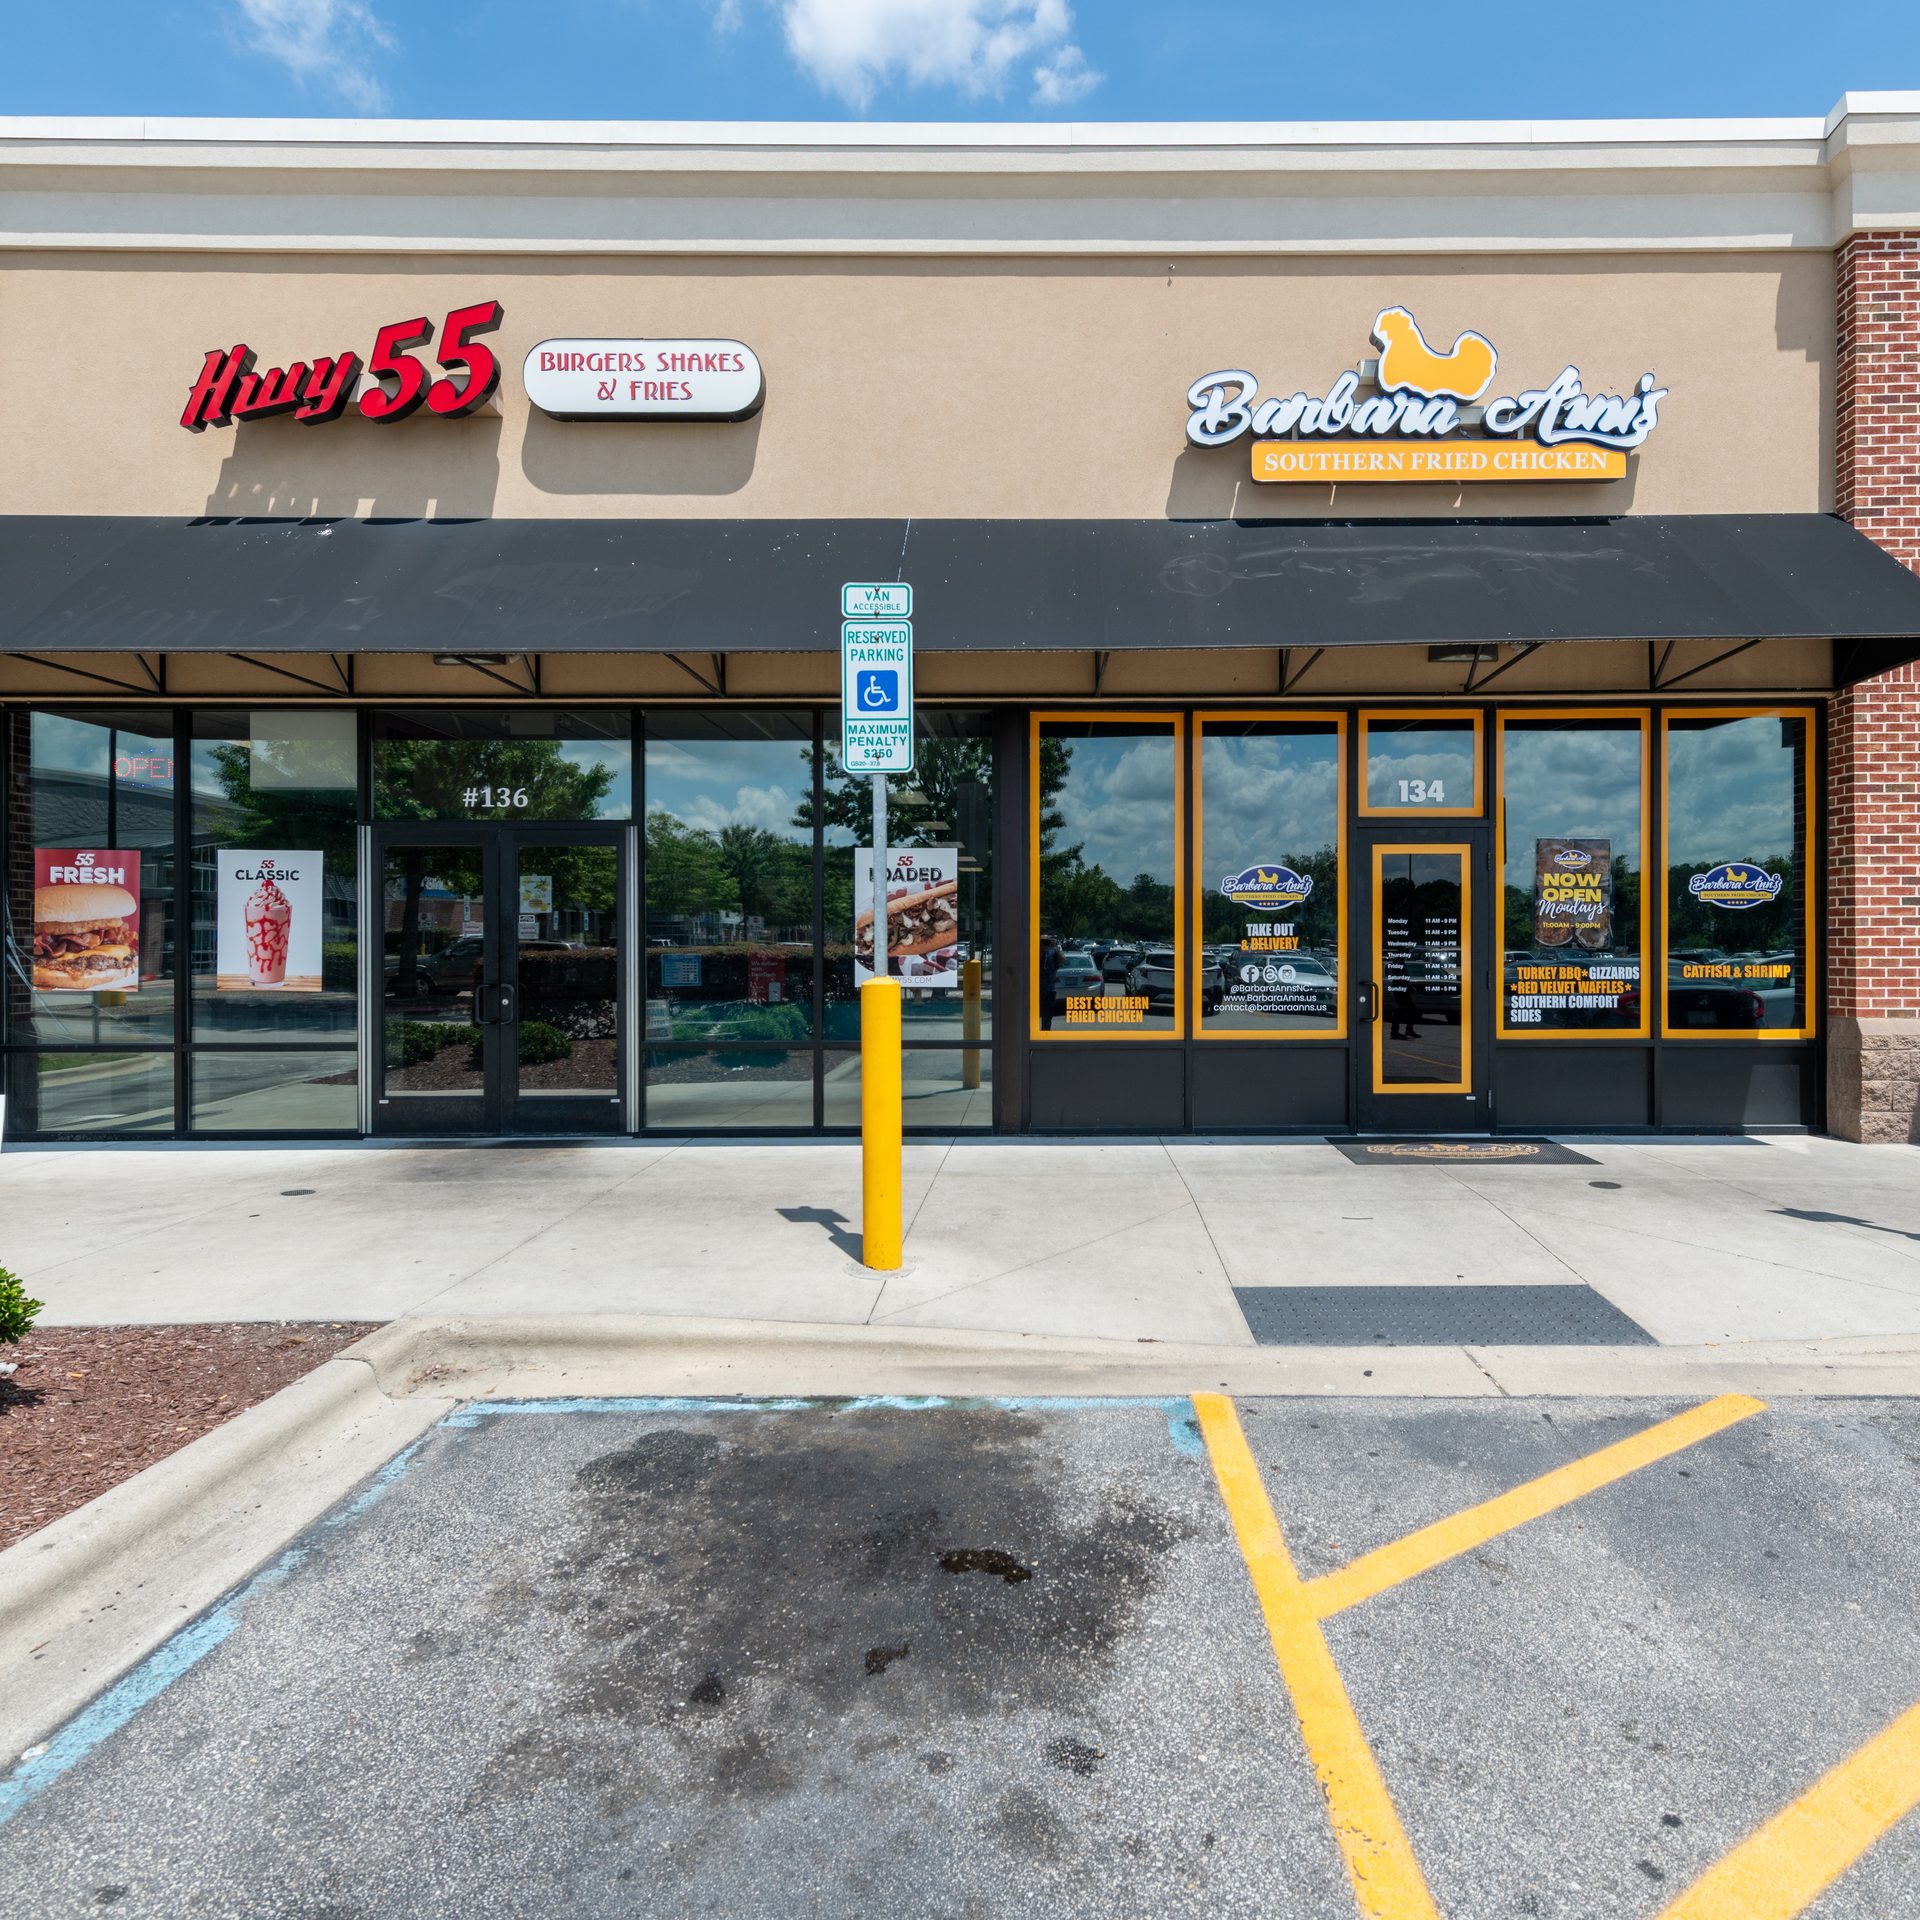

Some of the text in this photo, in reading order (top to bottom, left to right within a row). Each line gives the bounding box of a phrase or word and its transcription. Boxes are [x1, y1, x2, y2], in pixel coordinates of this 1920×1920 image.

[180, 300, 503, 431] Hwy 55
[540, 351, 745, 372] BURGERS SHAKES
[597, 378, 693, 401] & FRIES
[1187, 365, 1669, 448] Barbara Ann's
[1264, 451, 1609, 471] SOUTHERN FRIED CHICKEN
[865, 591, 890, 601] VAN
[853, 603, 901, 611] ACCESSIBLE
[847, 631, 907, 644] RESERVED
[850, 648, 904, 662] PARKING
[848, 725, 908, 734] MAXIMUM
[849, 737, 907, 746] PENALTY
[462, 787, 529, 808] #136
[1398, 780, 1445, 802] 134
[74, 853, 95, 866] 55
[260, 860, 275, 868] 55
[897, 856, 914, 866] 55
[50, 866, 125, 885] FRESH
[235, 869, 300, 881] CLASSIC
[1543, 872, 1602, 887] NOW
[1224, 876, 1312, 893] Barbara Ann's
[1692, 876, 1781, 892] Barbara Ann's
[1542, 888, 1602, 902] OPEN
[1538, 898, 1606, 920] Mondays
[1246, 923, 1295, 936] TAKE OUT
[1240, 937, 1299, 950] & DELIVERY
[1517, 966, 1558, 980] TURKEY
[1588, 966, 1640, 980] GIZZARDS
[1683, 965, 1791, 978] CATFISH & SHRIMP
[1230, 984, 1310, 994] @BarbaraAnnsNC
[1540, 982, 1576, 994] VELVET
[1066, 996, 1149, 1010] BEST SOUTHERN
[1224, 994, 1317, 1002] www.BarbaraAnns.us
[1511, 996, 1620, 1008] SOUTHERN COMFORT
[1213, 1004, 1328, 1012] contact@barbaraanns.us
[1066, 1010, 1144, 1023] FRIED CHICKEN
[1510, 1009, 1542, 1022] SIDES
